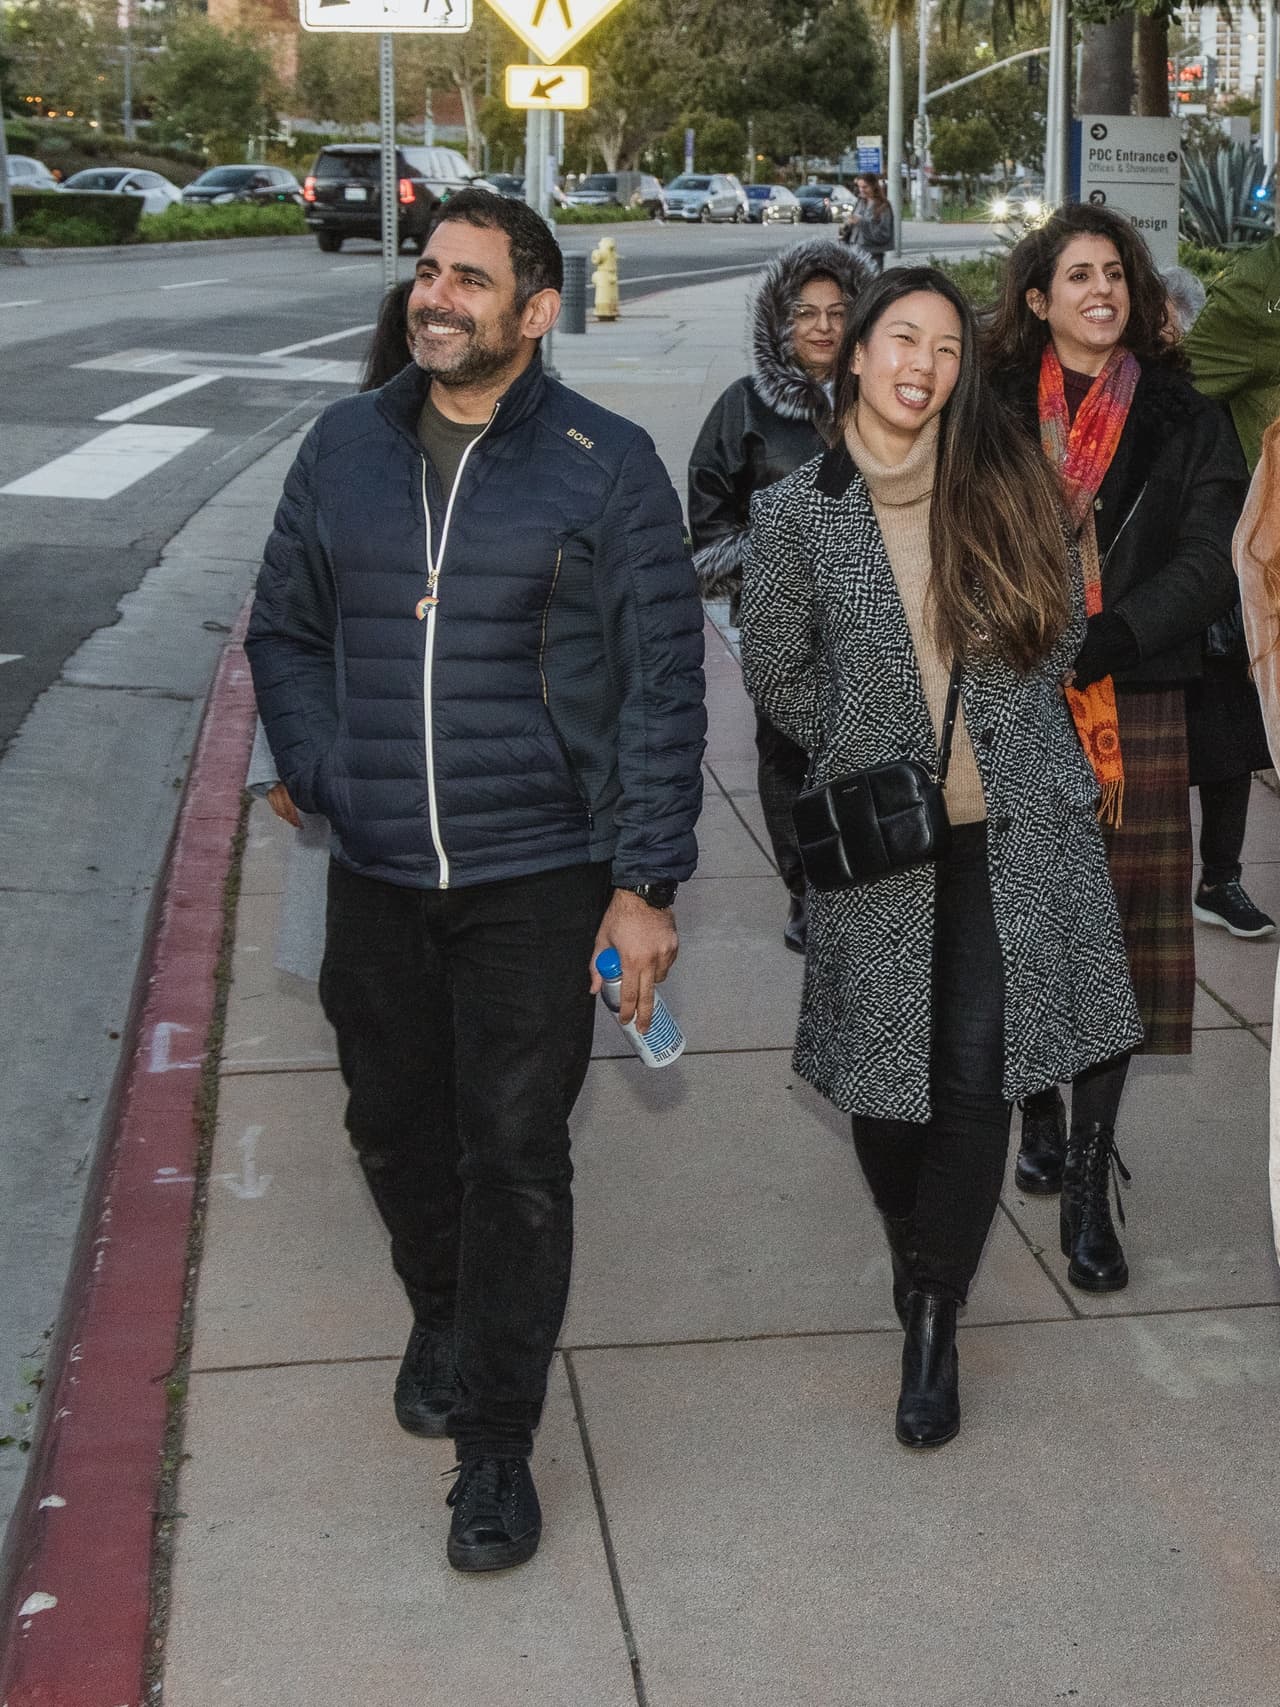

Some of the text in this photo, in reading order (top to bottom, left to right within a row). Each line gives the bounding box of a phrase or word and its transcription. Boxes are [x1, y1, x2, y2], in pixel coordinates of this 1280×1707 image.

[1088, 148, 1165, 162] PDC Entrance
[1088, 163, 1169, 174] Offices & Showrooms
[566, 428, 595, 449] BOSS
[654, 1034, 684, 1062] STILL WATER
